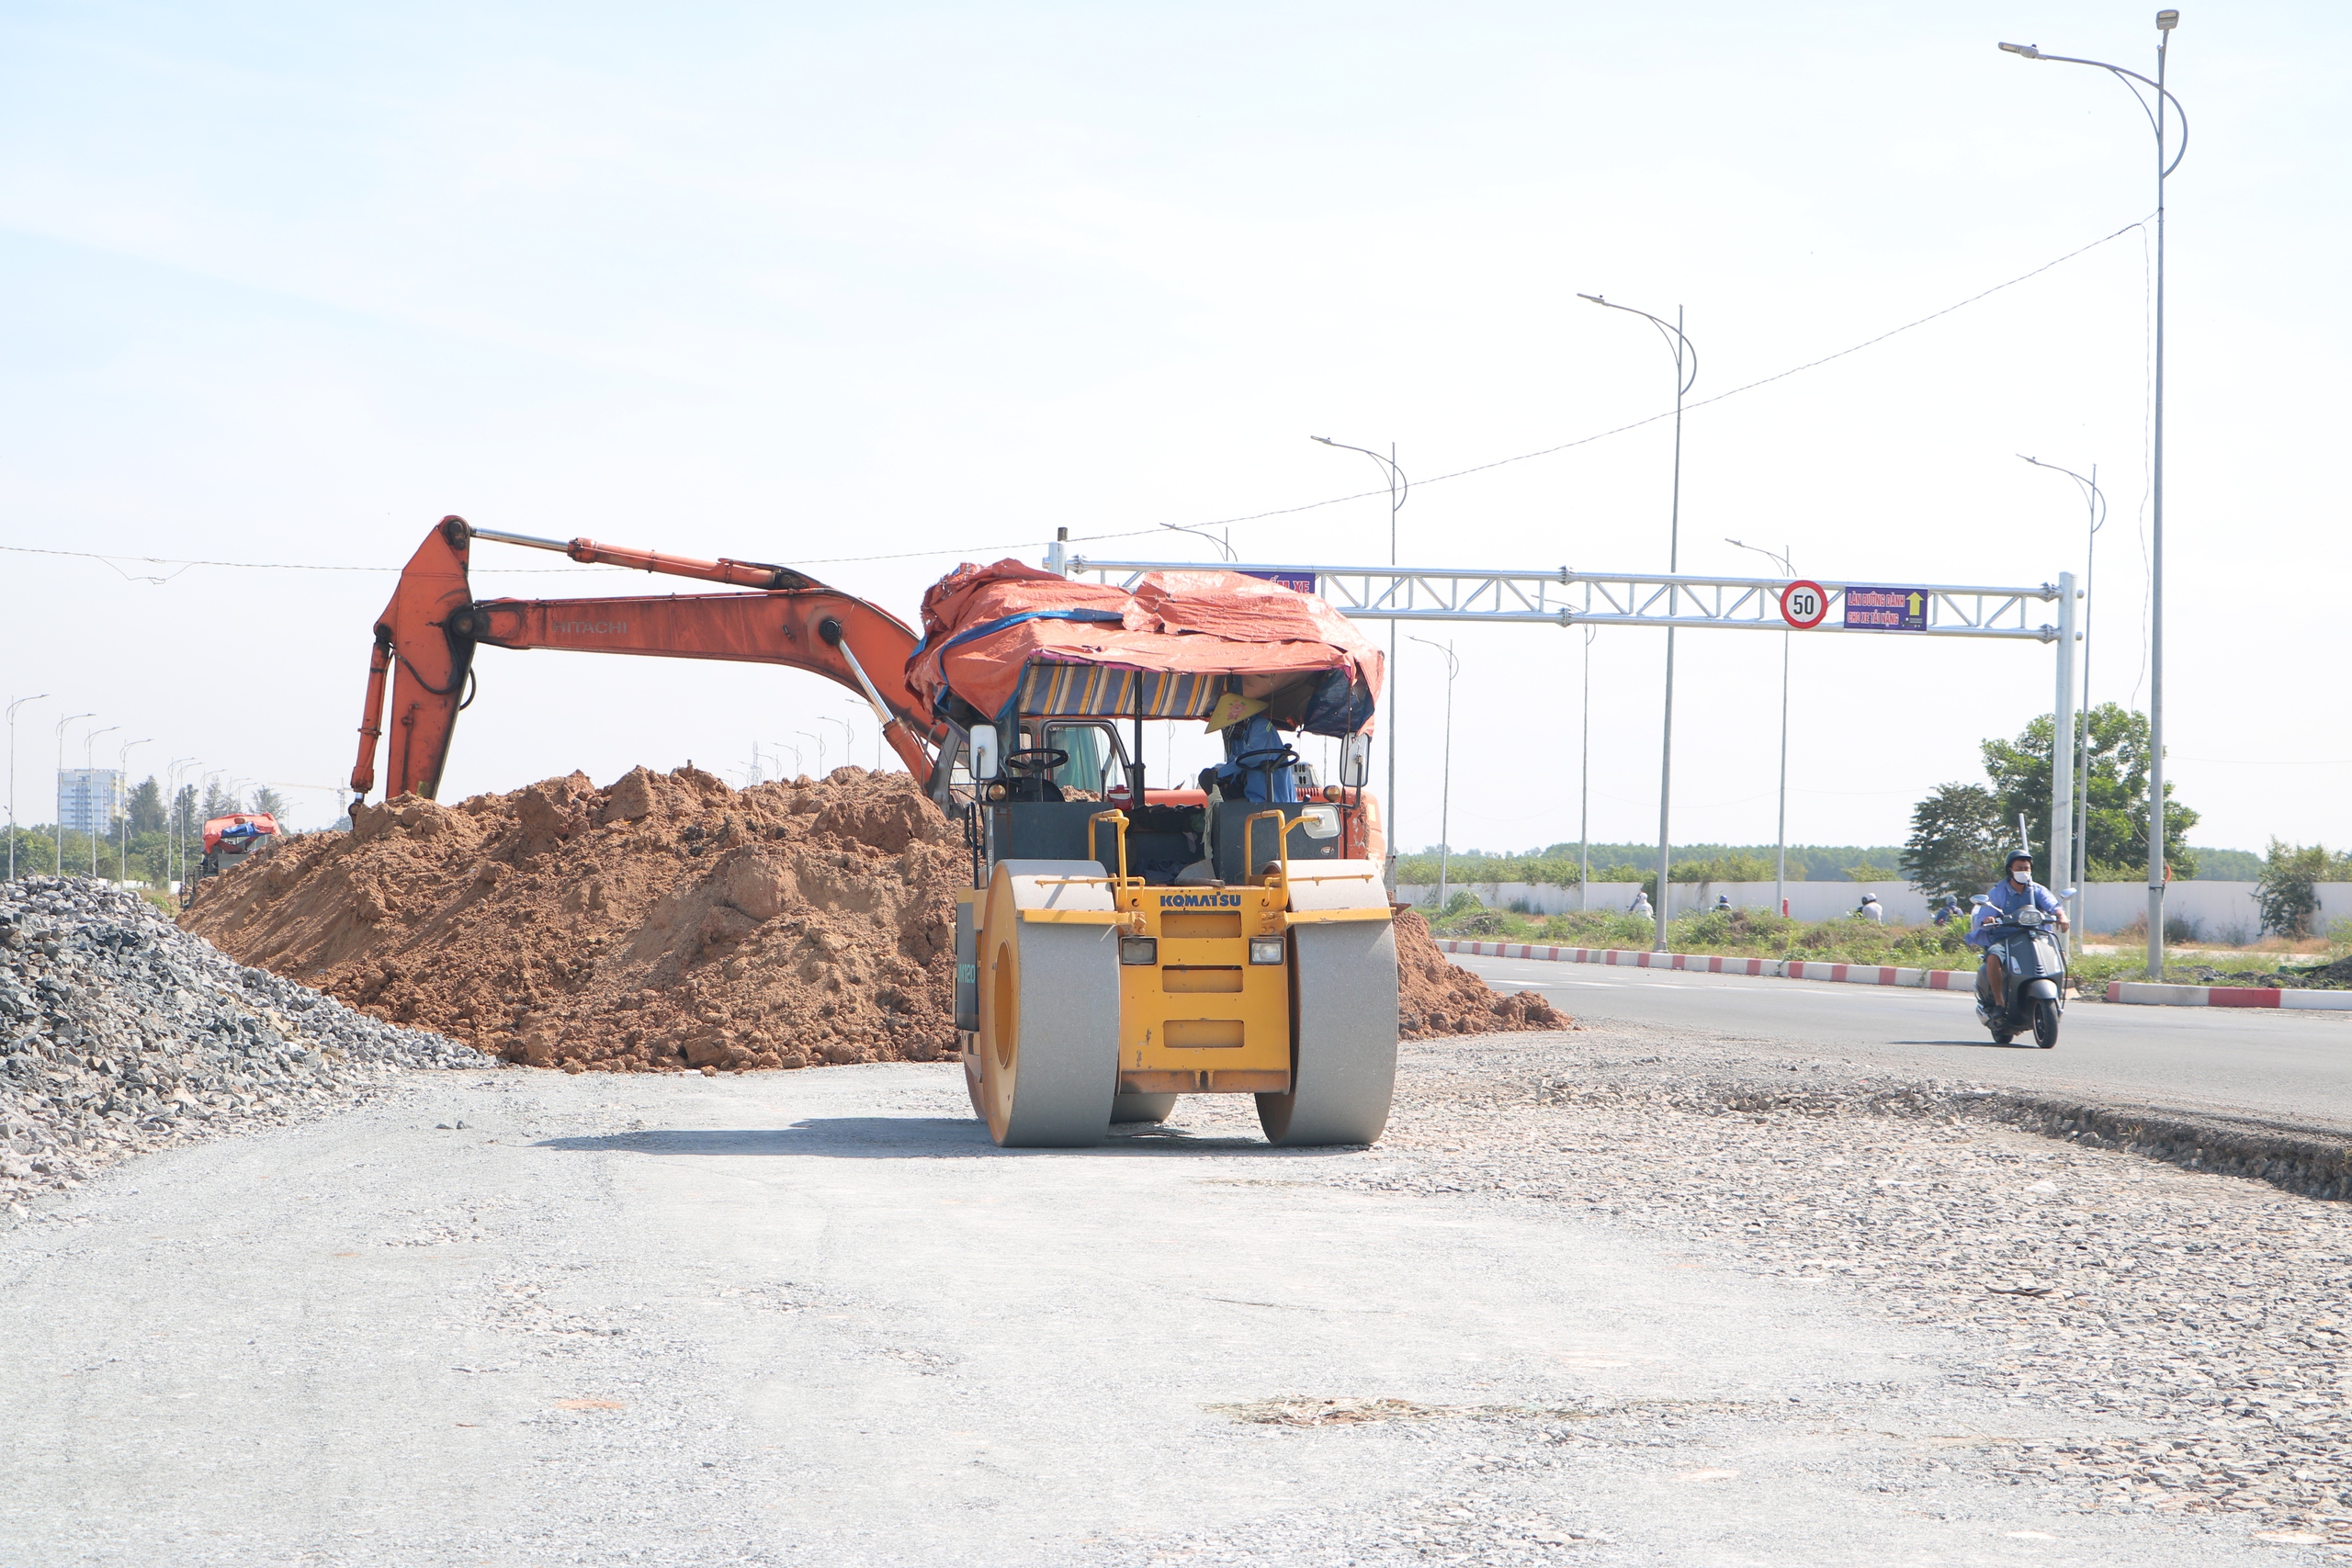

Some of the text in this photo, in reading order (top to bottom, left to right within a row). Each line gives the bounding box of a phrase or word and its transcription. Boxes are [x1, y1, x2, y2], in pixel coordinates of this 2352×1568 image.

[1793, 594, 1815, 615] 50
[1848, 590, 1905, 608] LÀN ĐƯỜNG DÀNH
[1848, 608, 1899, 626] CHO XE TẢI NẶNG
[552, 620, 628, 634] HITACHI
[1159, 891, 1241, 907] KOMATSU
